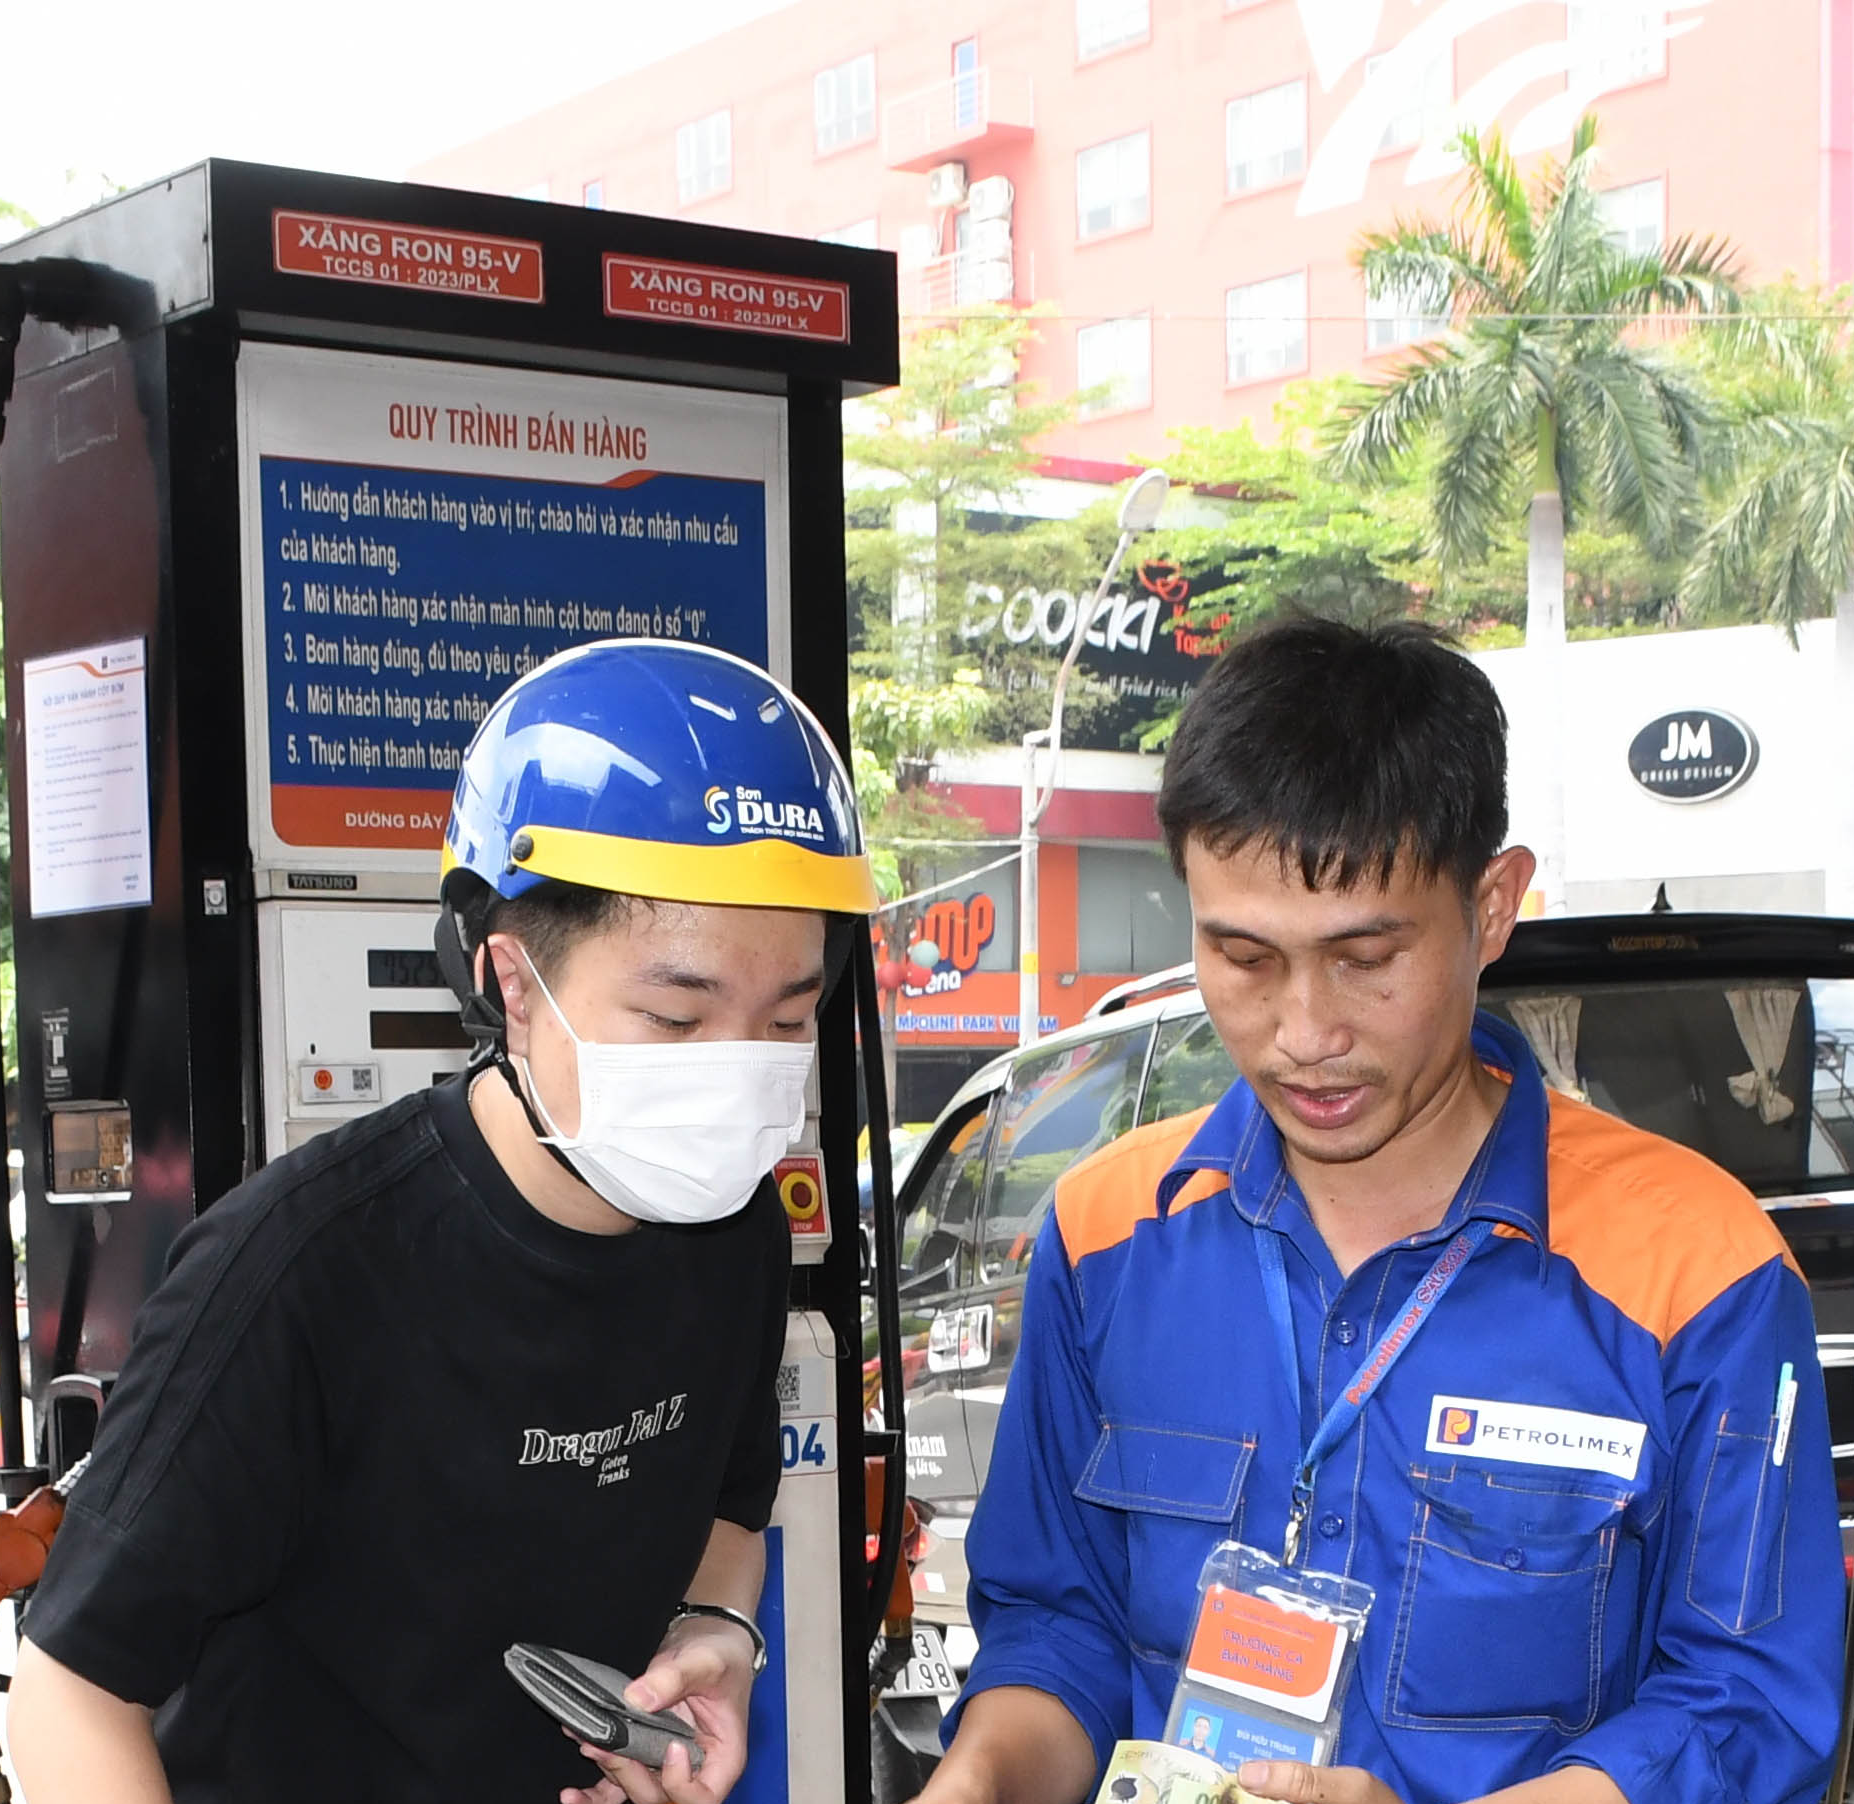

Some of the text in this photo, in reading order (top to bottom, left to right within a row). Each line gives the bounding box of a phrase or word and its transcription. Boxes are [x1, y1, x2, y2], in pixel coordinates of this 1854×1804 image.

[298, 223, 521, 274] XĂNG RON 95-V
[322, 255, 374, 277] TCCS
[380, 263, 399, 281] 01
[418, 267, 500, 293] 2023/PLX
[630, 268, 824, 313] XĂNG RON 95-V
[699, 305, 717, 319] 01
[733, 309, 808, 330] 2023/PLX
[389, 402, 646, 461] QUY TRÌNH BÁN HÀNG
[279, 480, 292, 510] 1.
[383, 488, 428, 521] khách
[431, 492, 466, 531] hàng
[471, 496, 496, 526] vào
[499, 499, 512, 535] vị
[539, 499, 572, 533] chào
[600, 507, 616, 536] và
[620, 509, 644, 538] xác
[648, 510, 681, 547] nhận
[685, 514, 710, 543] nhu
[281, 529, 400, 576] của khách hàng.
[282, 581, 295, 611] 2.
[333, 584, 377, 616] khách
[382, 588, 418, 627] hàng
[422, 591, 447, 621] xác
[451, 592, 486, 630] nhận
[490, 595, 520, 626] màn
[558, 600, 580, 637] cột
[616, 604, 650, 638] đang
[283, 632, 297, 662] 3.
[305, 633, 339, 665] Bơm
[343, 636, 379, 675] hàng
[450, 642, 481, 673] theo
[485, 645, 510, 681] yêu
[286, 683, 299, 713] 4.
[337, 686, 381, 718] khách
[385, 688, 421, 727] hàng
[425, 691, 450, 721] xác
[287, 734, 461, 774] 5. Thực hiện thanh toán
[1660, 719, 1713, 762] JM
[1684, 765, 1733, 780] DESIGN
[735, 785, 762, 800] Sơn
[345, 809, 443, 830] ĐƯỜNG DÂY
[737, 801, 824, 833] DURA
[291, 875, 354, 889] TATSUNO
[963, 1015, 995, 1032] PARK
[793, 1222, 813, 1231] STOP
[1346, 1305, 1423, 1406] Petrolimex
[518, 1425, 624, 1467] Dragon
[665, 1393, 687, 1431] Z
[781, 1422, 826, 1468] 04
[906, 1432, 947, 1457] tnam
[1482, 1424, 1634, 1459] PETROLIMEX
[597, 1466, 630, 1487] Trunks
[601, 1454, 628, 1472] Goten
